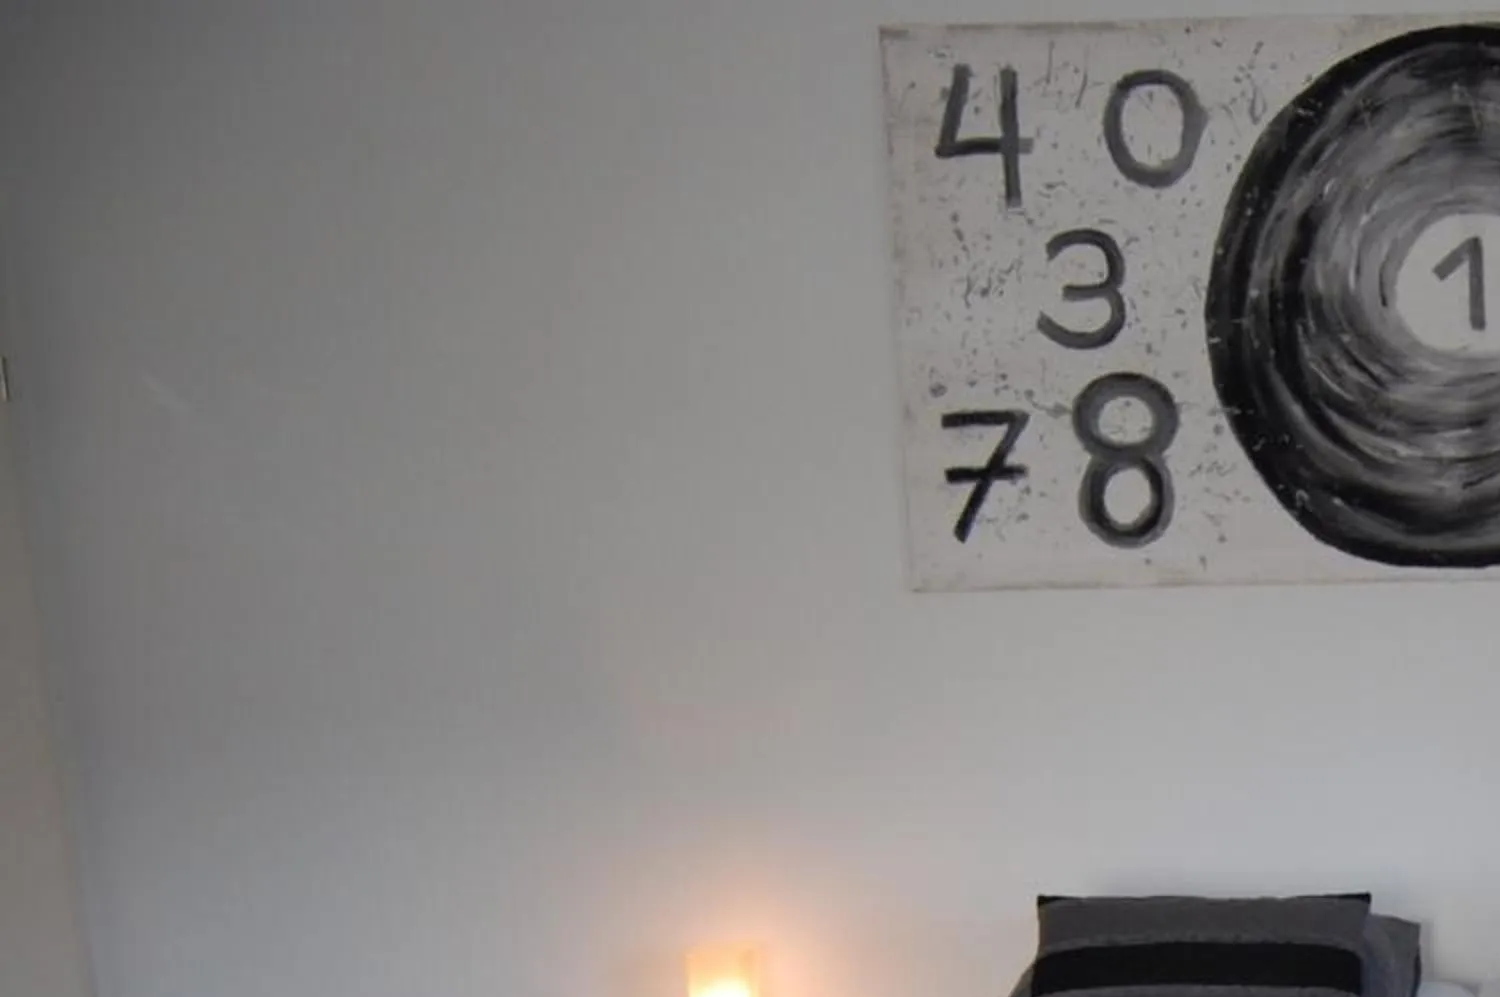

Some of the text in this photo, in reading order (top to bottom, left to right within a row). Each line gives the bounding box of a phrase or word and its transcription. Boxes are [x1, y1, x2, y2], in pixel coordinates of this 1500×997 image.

[934, 63, 1208, 208] 4 0
[1037, 228, 1126, 349] 3
[1431, 235, 1486, 331] 1
[941, 372, 1181, 549] 7 8
